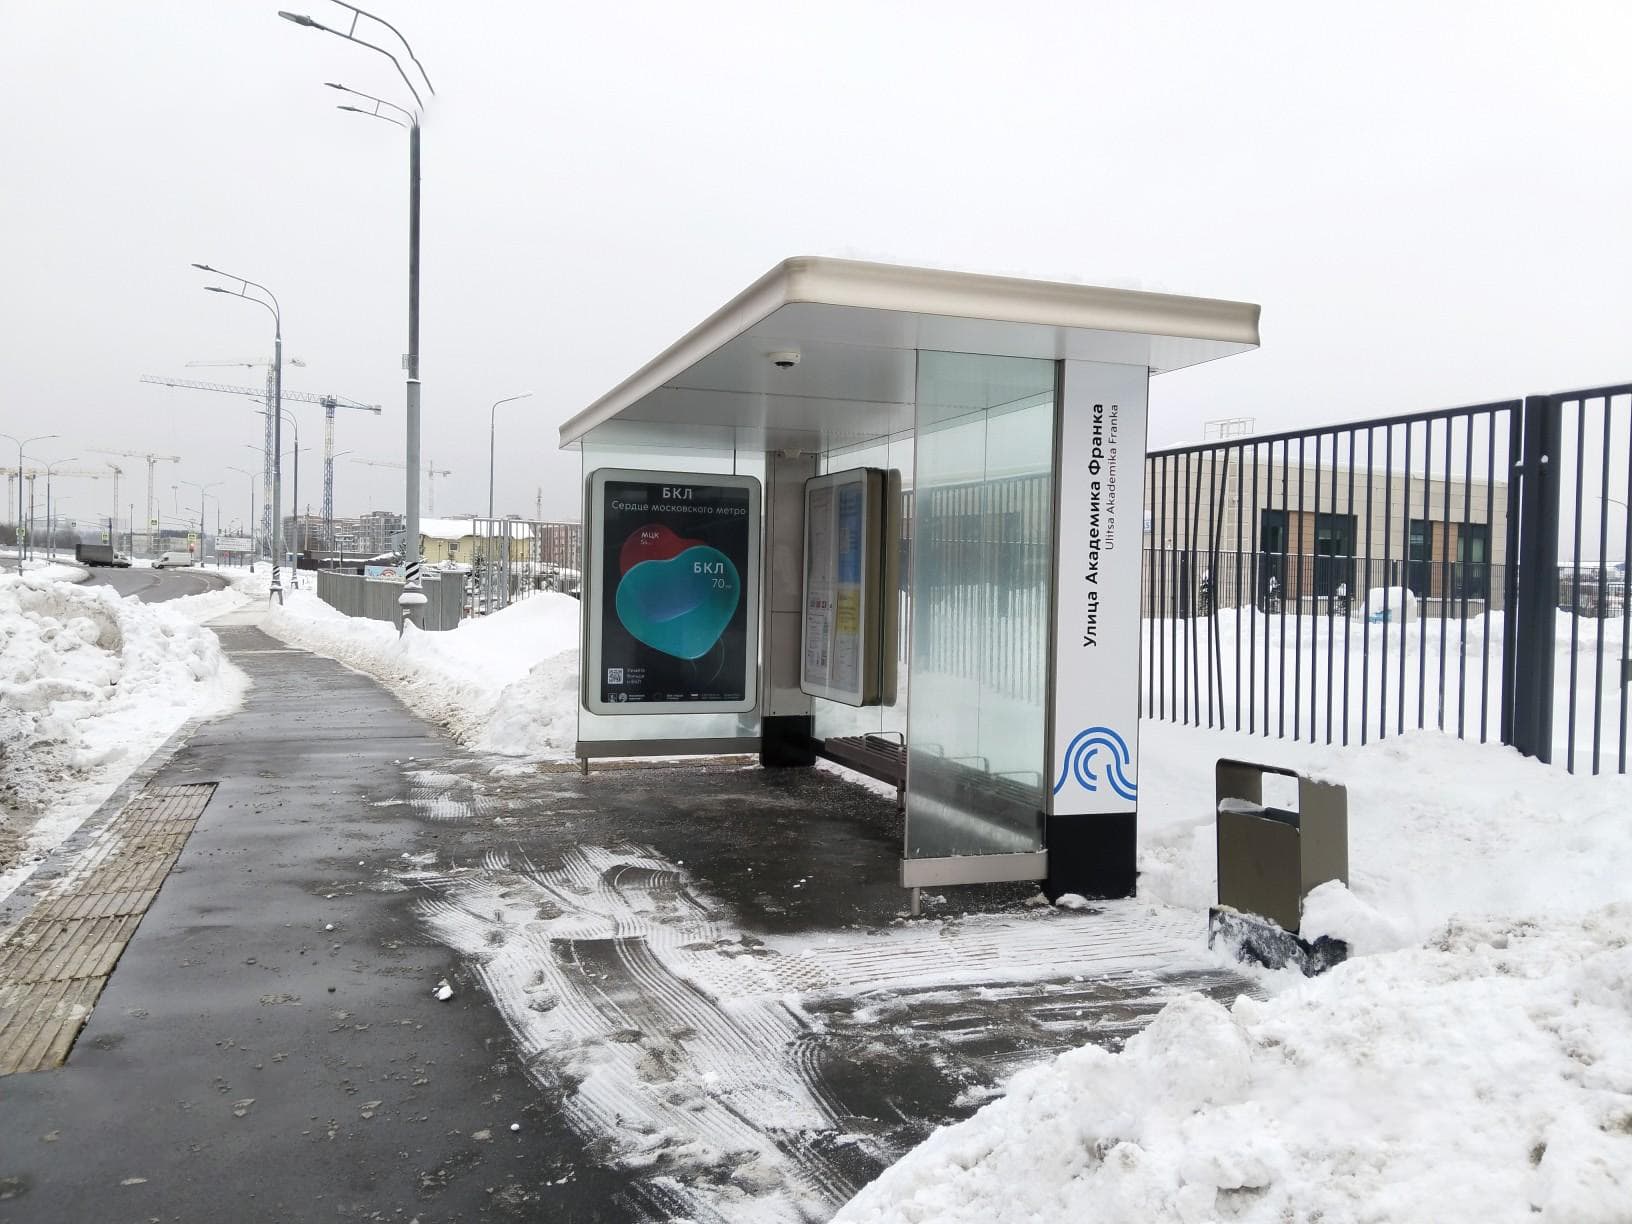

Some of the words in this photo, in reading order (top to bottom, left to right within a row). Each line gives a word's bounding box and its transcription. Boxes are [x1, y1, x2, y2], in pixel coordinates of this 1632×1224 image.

[1088, 403, 1104, 476] Франка
[1108, 404, 1118, 444] Franka
[662, 487, 693, 500] БКЛ
[1106, 448, 1117, 514] Akademika
[611, 500, 649, 512] Сердце
[651, 504, 713, 515] московского
[715, 507, 747, 516] метро
[1085, 481, 1101, 584] Академика
[1105, 517, 1115, 550] Ulitsa
[693, 561, 724, 574] БКЛ
[711, 578, 725, 589] 70
[1083, 591, 1099, 647] Улица
